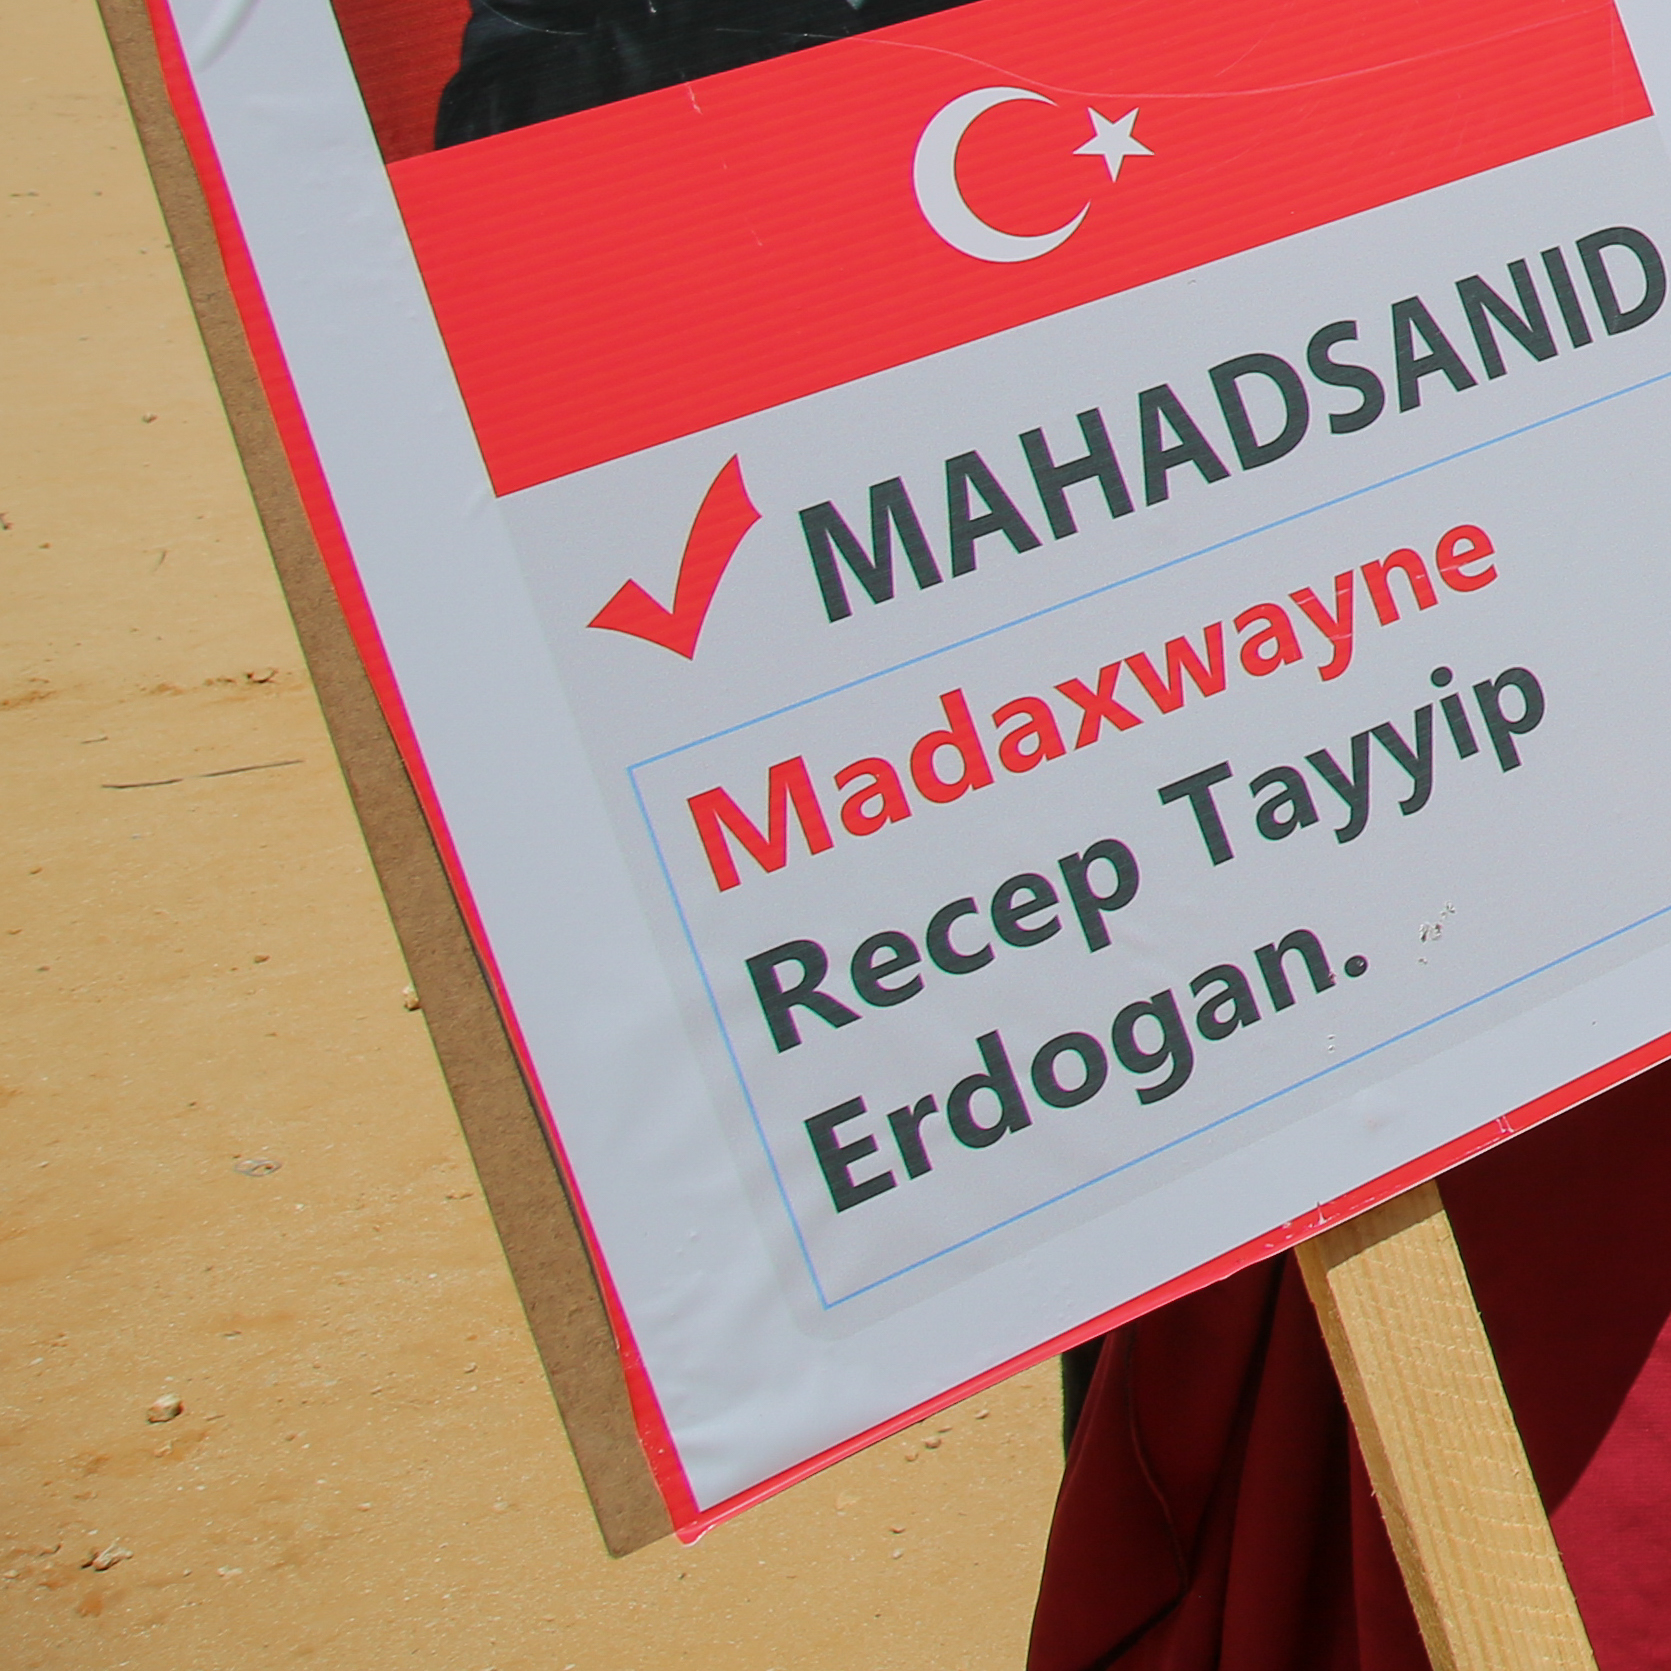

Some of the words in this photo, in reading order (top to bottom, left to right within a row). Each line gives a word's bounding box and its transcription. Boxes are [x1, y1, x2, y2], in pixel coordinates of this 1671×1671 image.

[797, 225, 1669, 624] MAHADSANID
[686, 523, 1501, 893] Madaxwayne
[744, 834, 1142, 1053] Recep
[1160, 665, 1546, 868] Tayyip
[804, 927, 1370, 1213] Erdogan.
